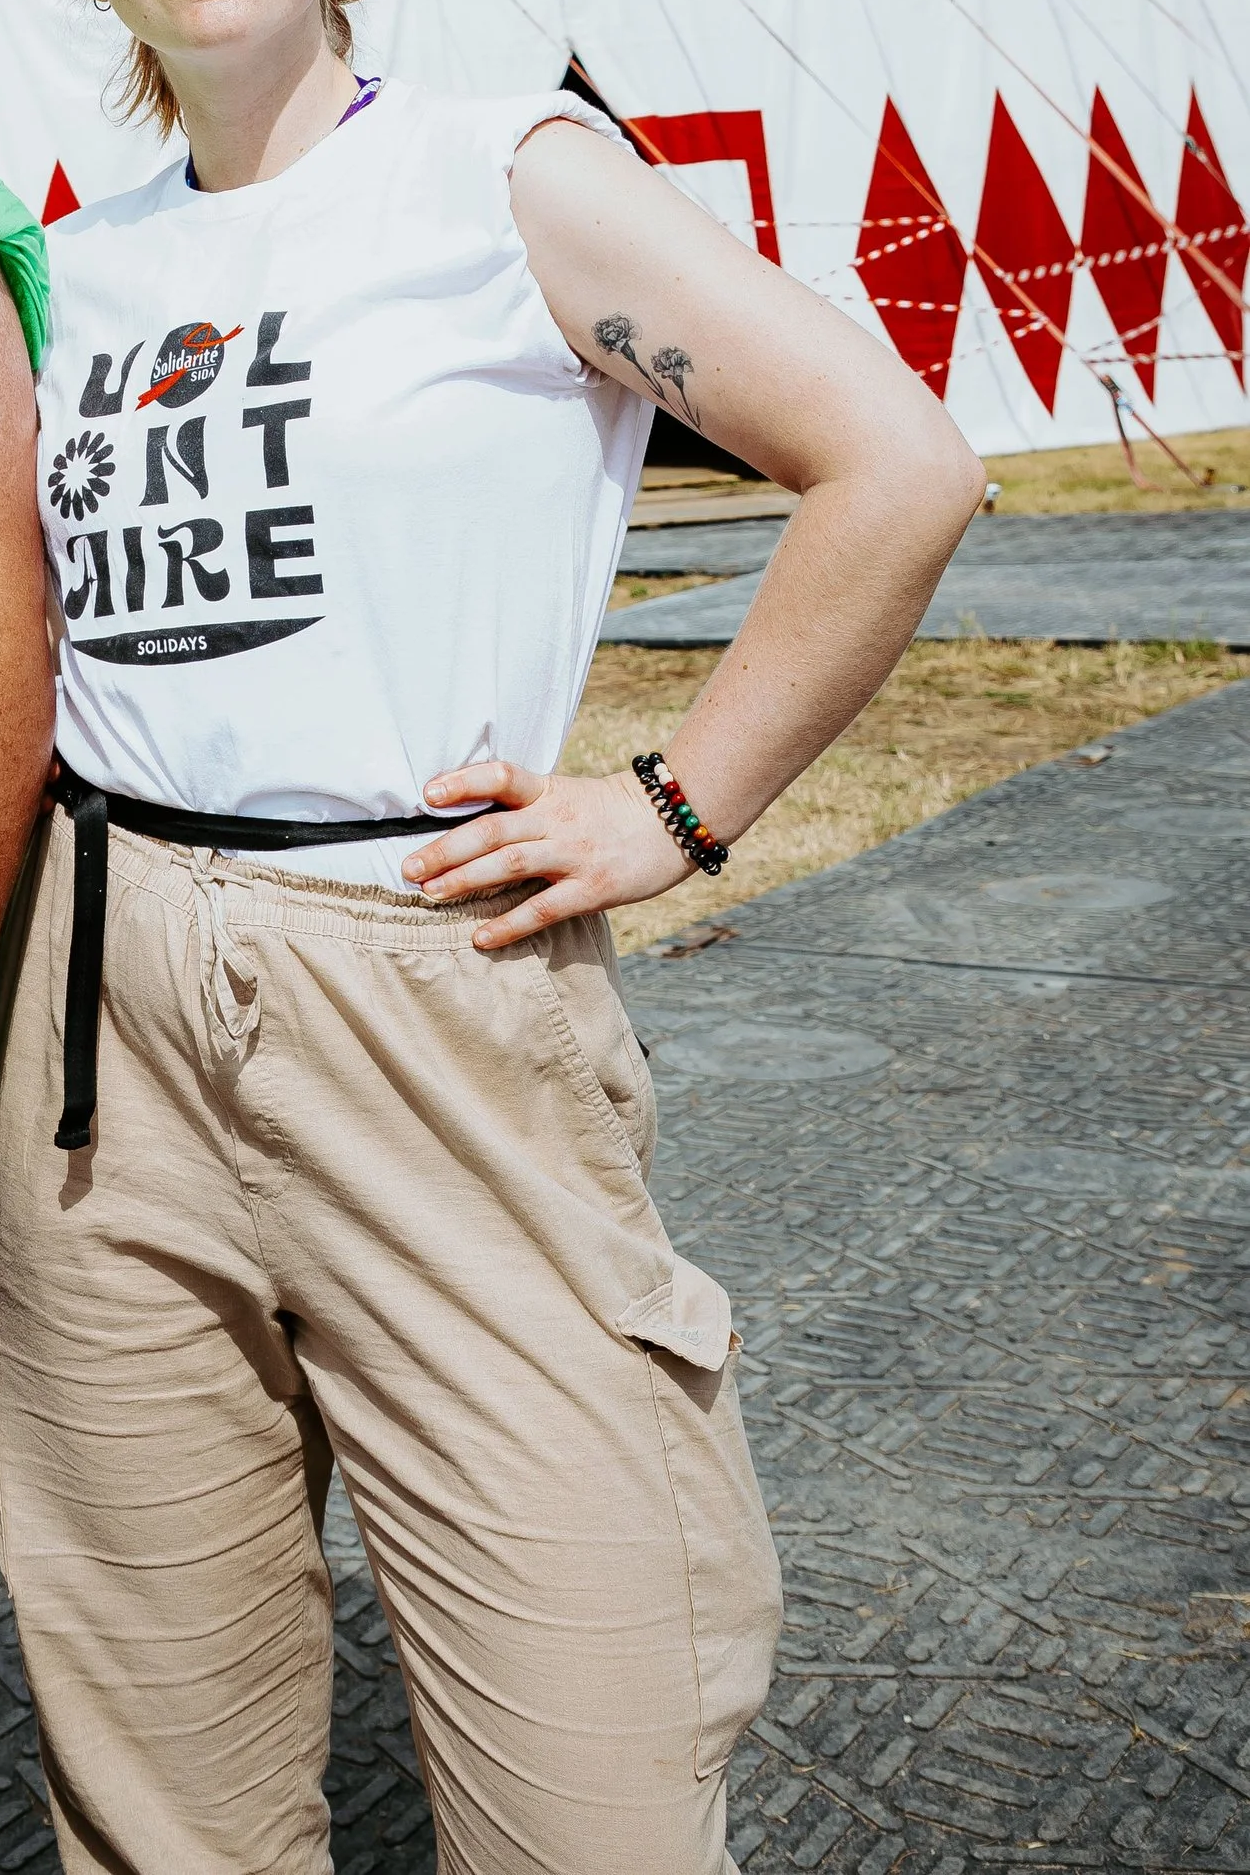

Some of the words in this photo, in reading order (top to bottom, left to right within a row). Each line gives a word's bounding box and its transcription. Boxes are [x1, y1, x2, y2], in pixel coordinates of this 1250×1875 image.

[153, 343, 219, 379] Solidarité
[64, 504, 324, 620] AIRE
[137, 635, 207, 656] SOLIDAYS
